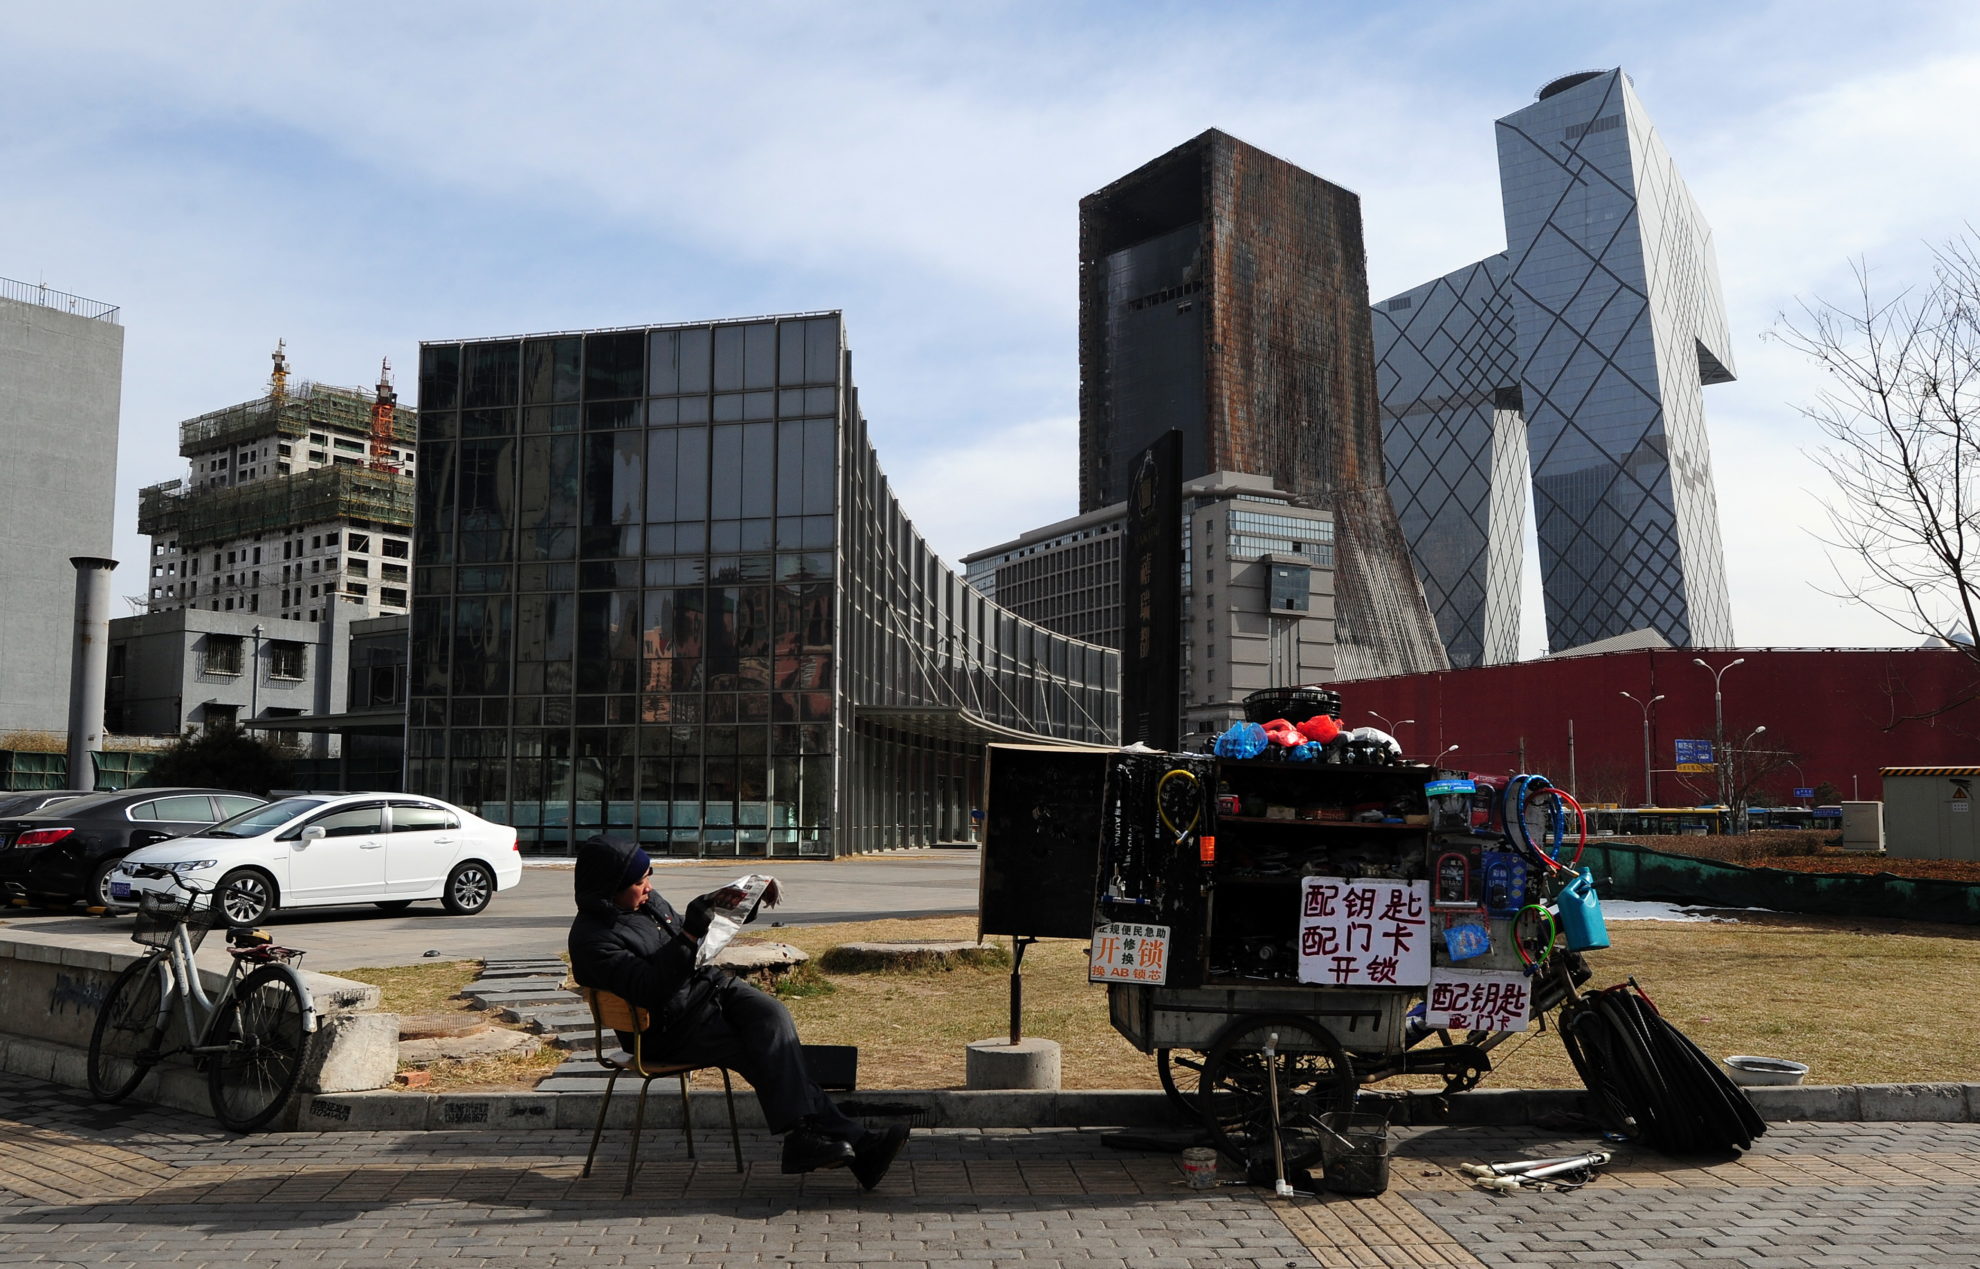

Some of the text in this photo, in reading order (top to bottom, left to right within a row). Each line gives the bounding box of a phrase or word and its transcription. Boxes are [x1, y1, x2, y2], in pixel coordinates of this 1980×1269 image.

[1304, 885, 1425, 924] 配钥匙
[1099, 924, 1166, 938] 正规便民急助
[1302, 921, 1413, 956] 配门卡
[1328, 955, 1399, 984] 开锁
[1431, 983, 1526, 1017] 配钥匙
[1449, 1013, 1510, 1031] 配门卡
